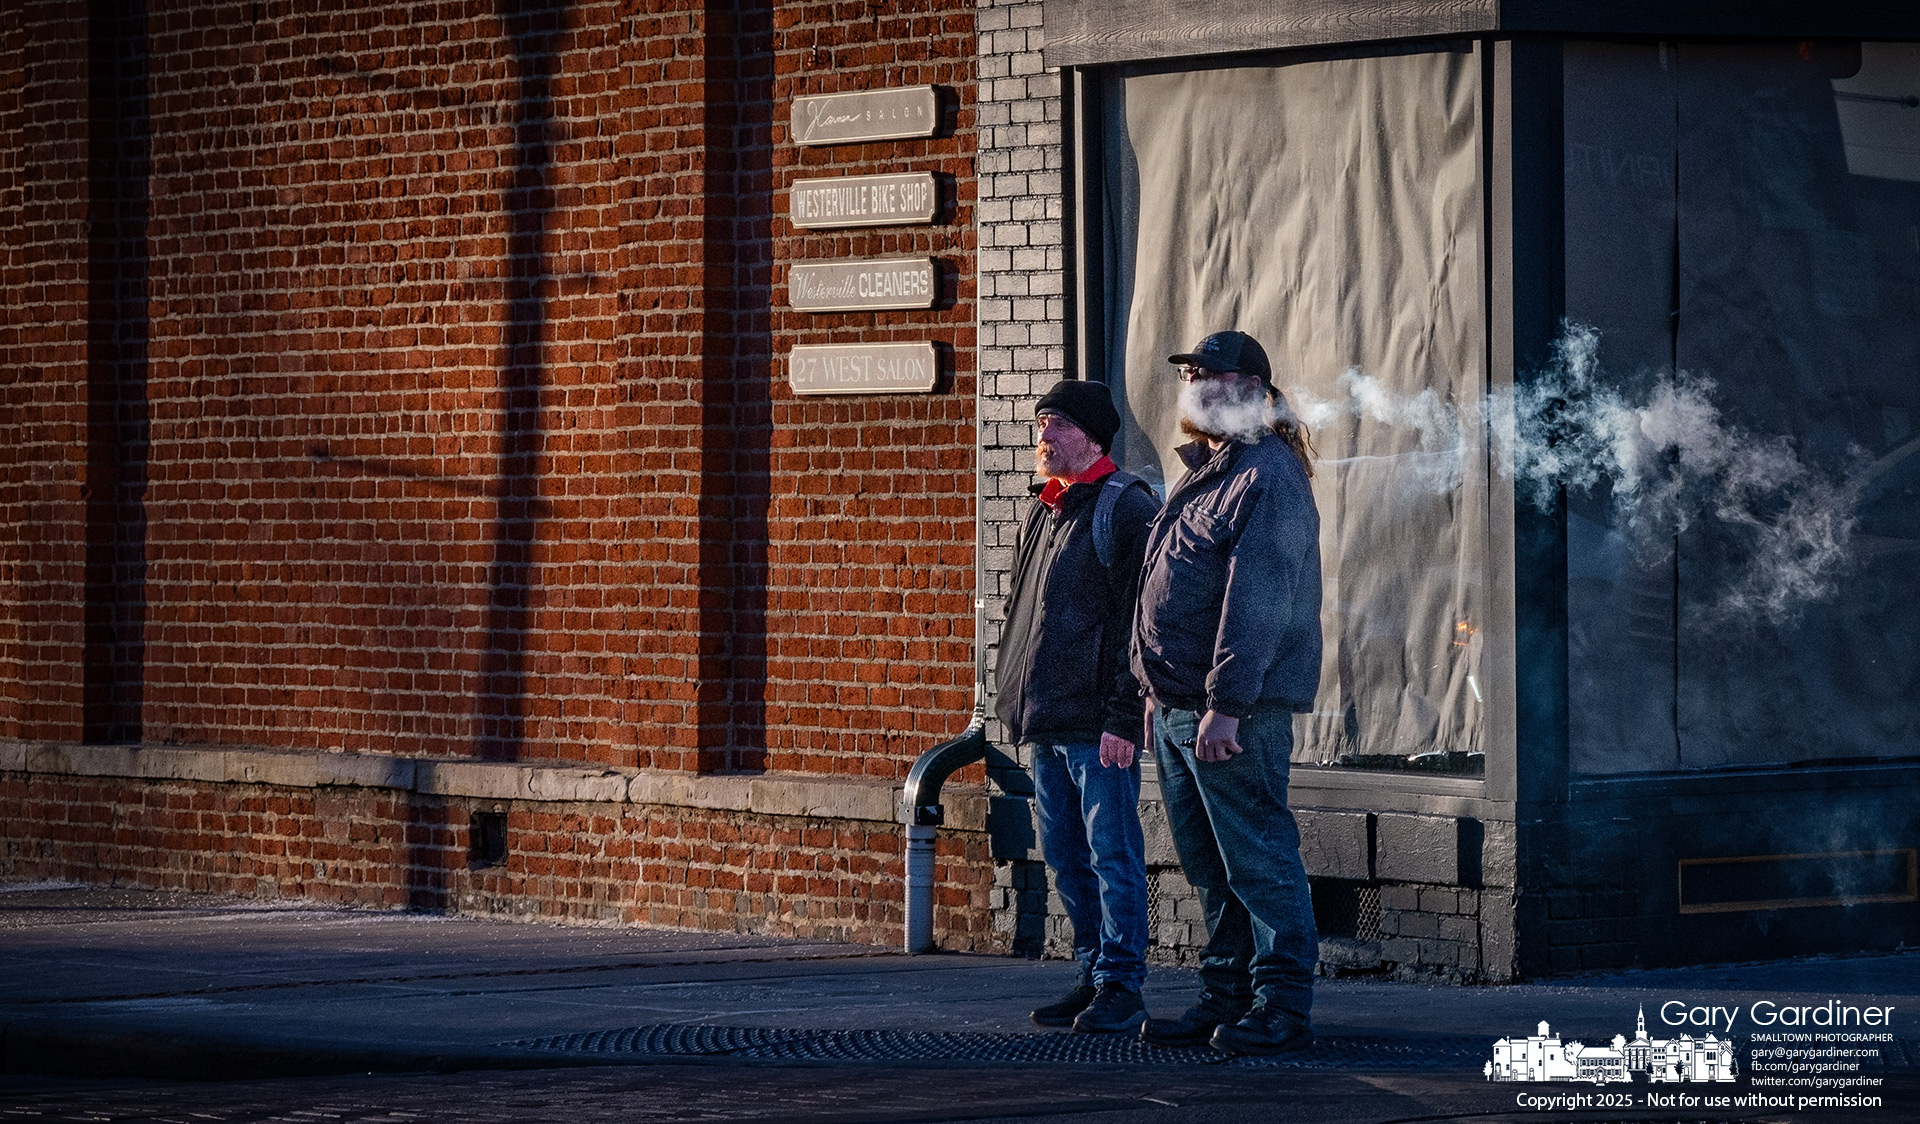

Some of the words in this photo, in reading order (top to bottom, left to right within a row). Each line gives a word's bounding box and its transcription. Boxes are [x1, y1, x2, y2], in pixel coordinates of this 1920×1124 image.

[866, 106, 923, 121] SALON
[797, 186, 867, 218] WESTERVILLE
[872, 184, 895, 213] BIKE
[900, 182, 928, 212] SHOP
[794, 273, 857, 300] Westerville
[858, 270, 929, 298] CLEANERS
[796, 358, 817, 383] 27
[822, 355, 873, 382] WEST
[877, 358, 926, 381] SALON
